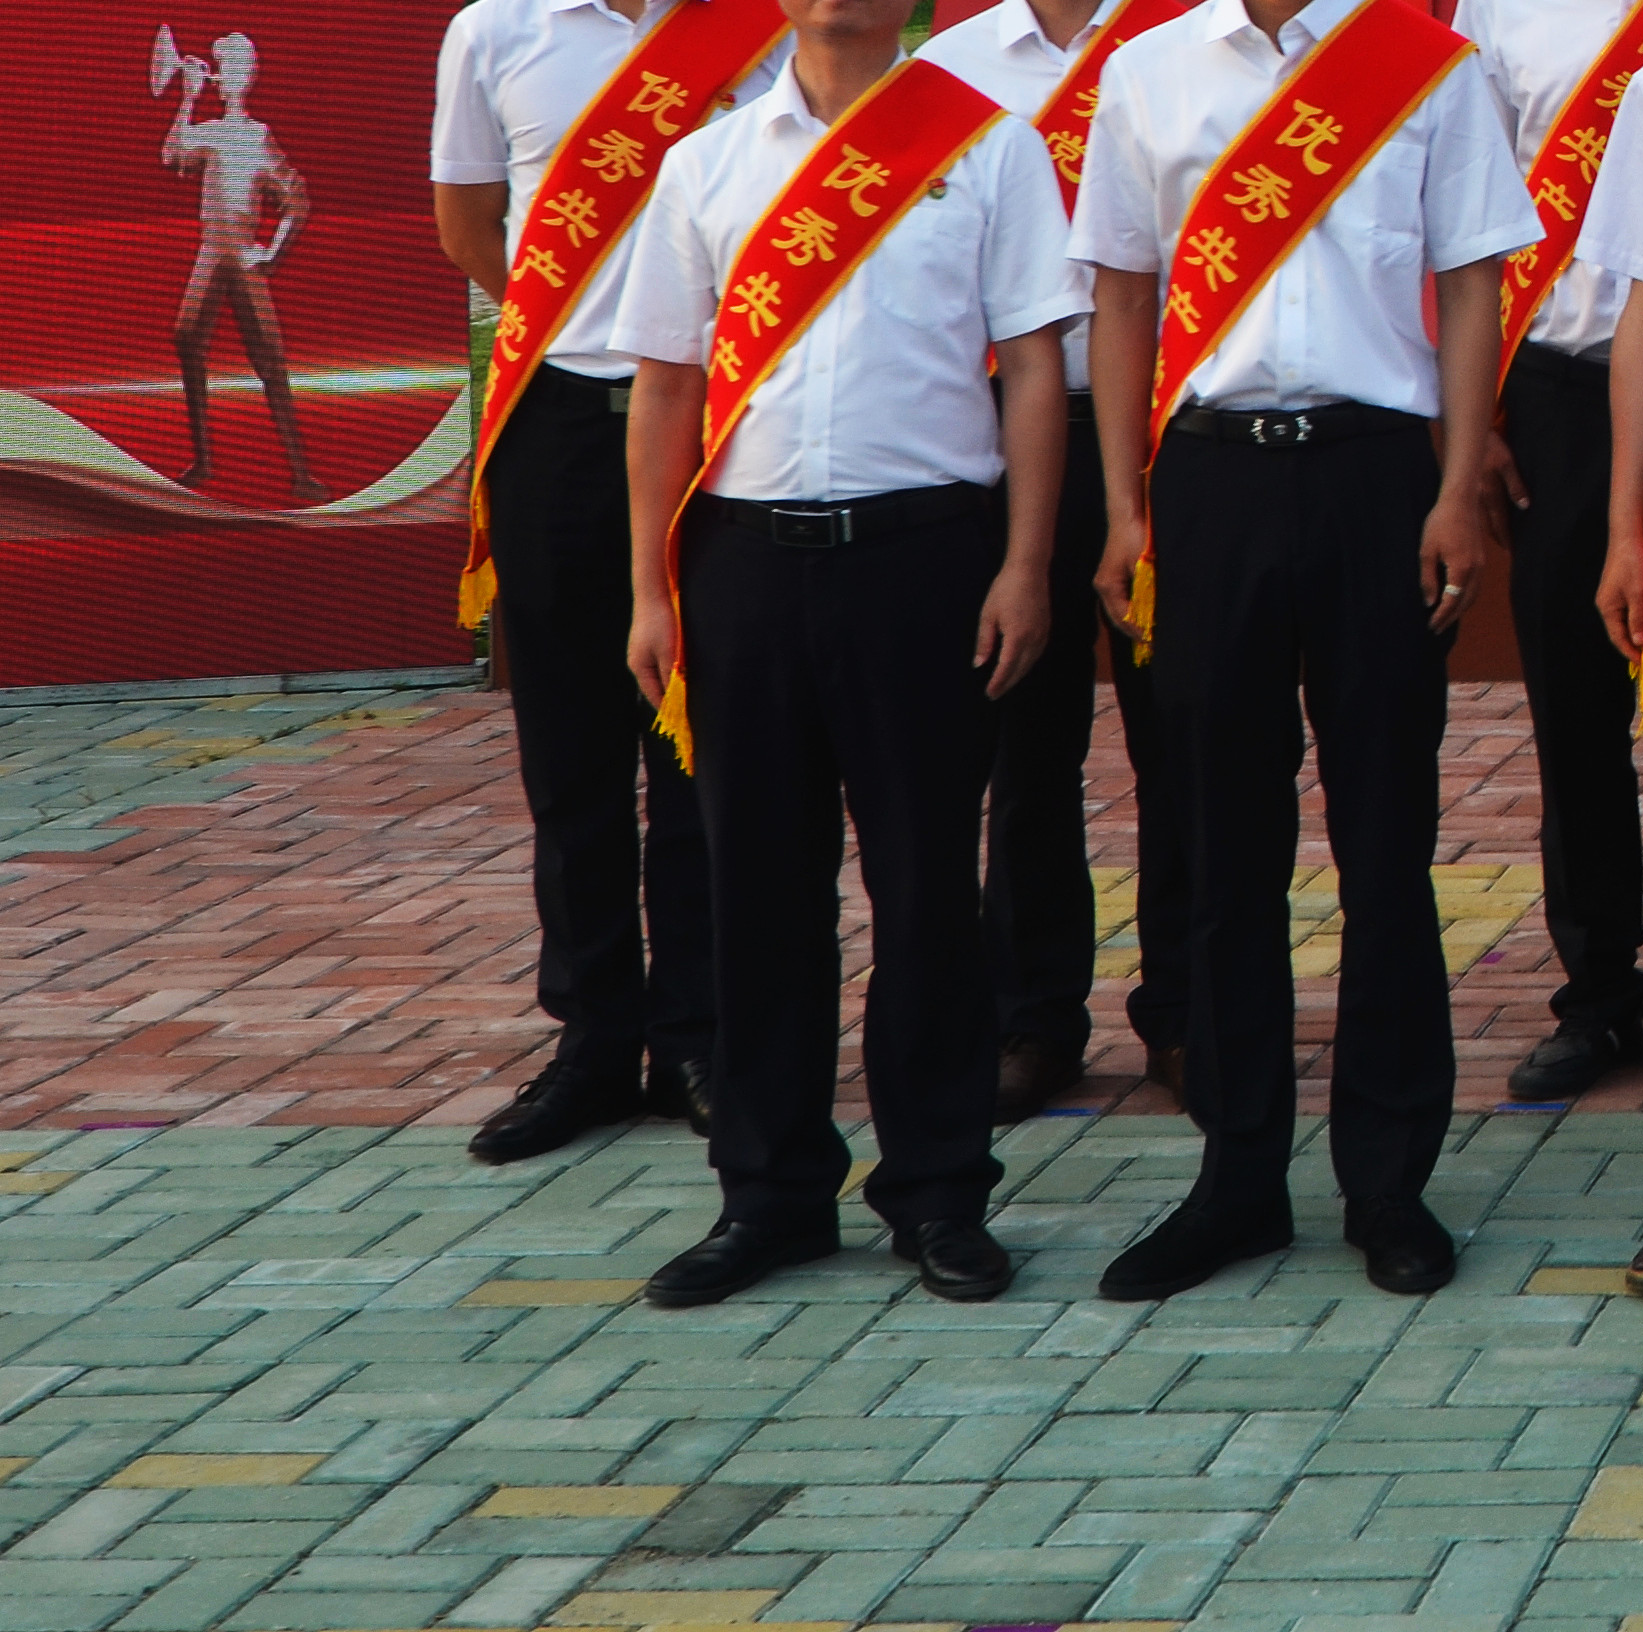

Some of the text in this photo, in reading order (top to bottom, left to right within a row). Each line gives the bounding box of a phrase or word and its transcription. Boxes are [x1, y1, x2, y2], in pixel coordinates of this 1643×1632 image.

[703, 143, 892, 446] 优秀共产
[1152, 99, 1342, 408] 优秀共产
